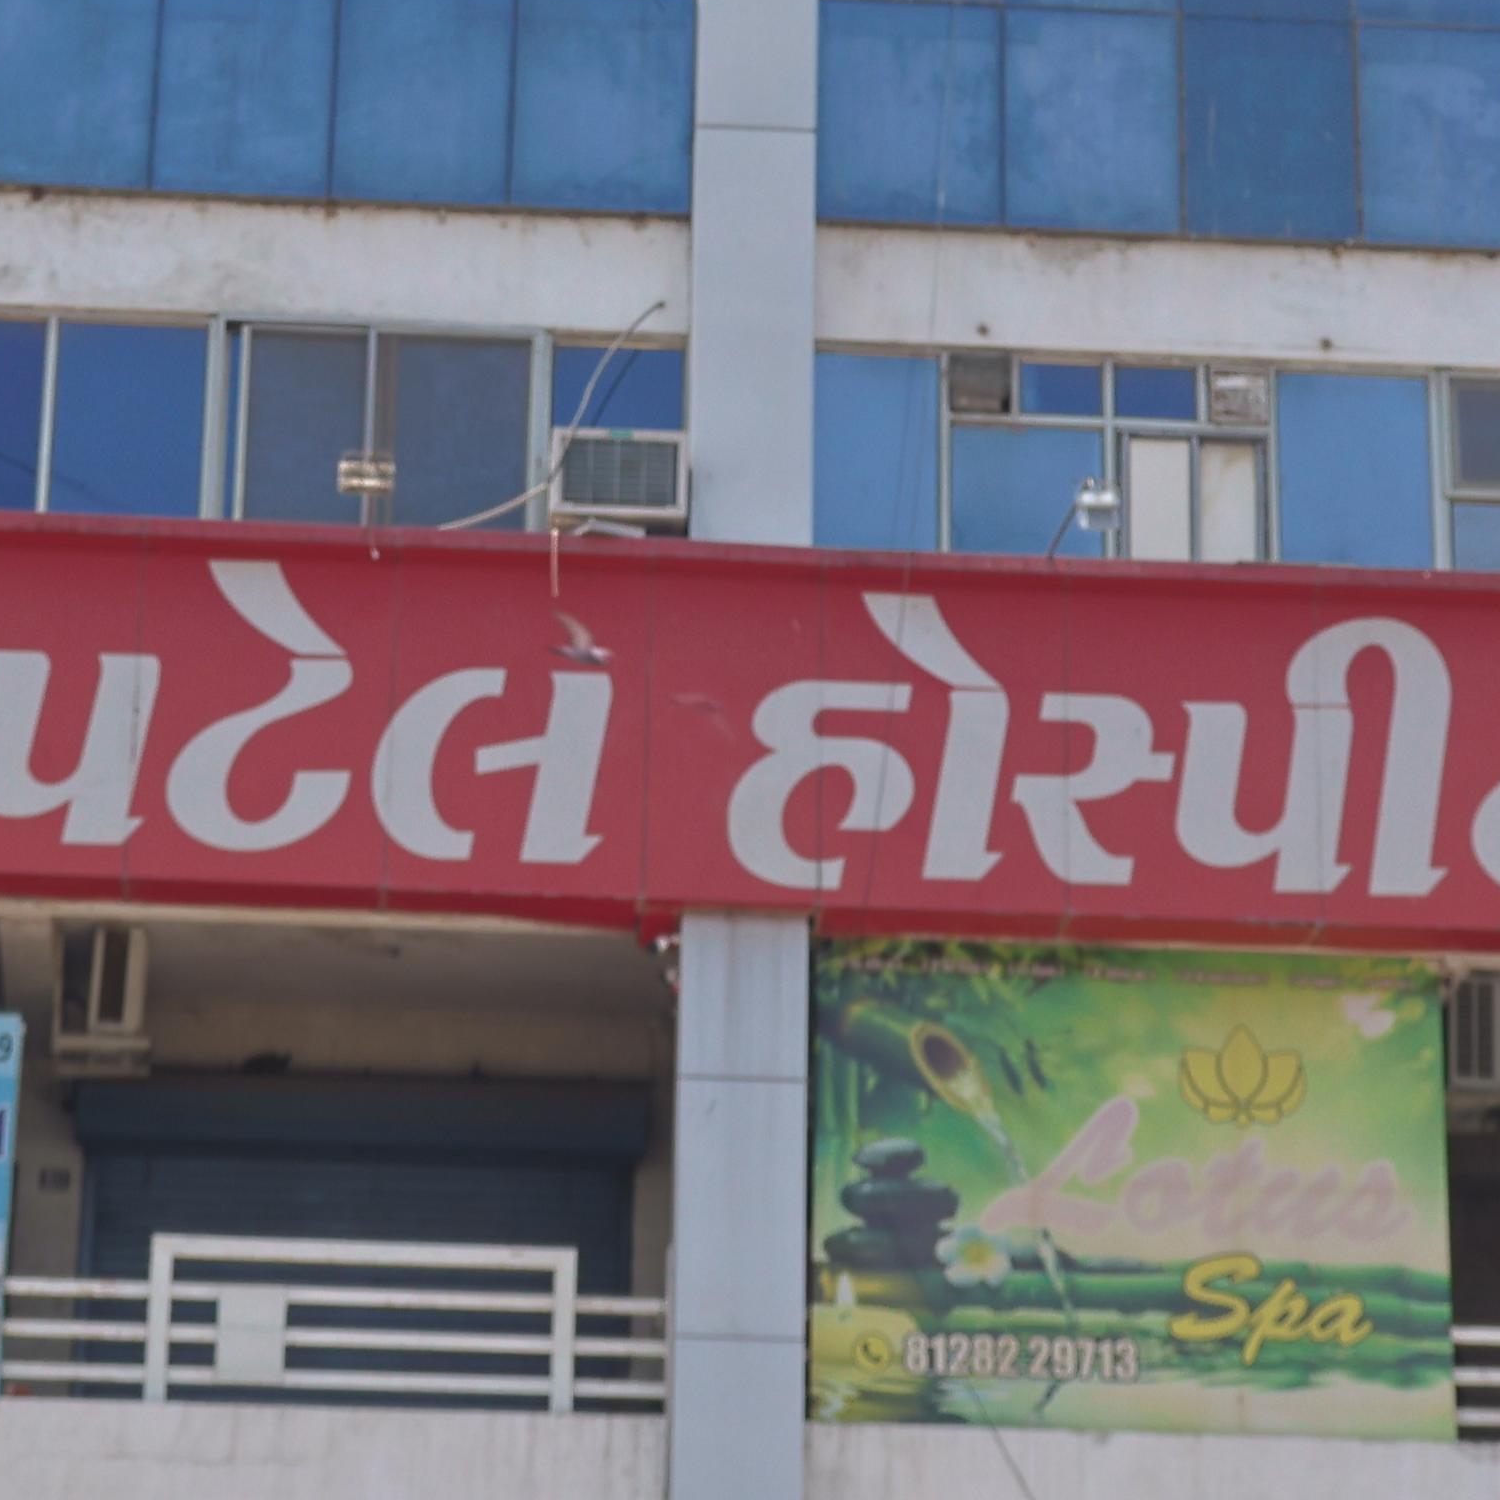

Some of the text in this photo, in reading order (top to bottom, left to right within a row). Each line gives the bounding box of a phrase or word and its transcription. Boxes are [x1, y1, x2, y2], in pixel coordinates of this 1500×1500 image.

[980, 1094, 1415, 1244] Lotus
[904, 1331, 1140, 1382] 81282 29713
[1167, 1251, 1375, 1368] Spa
